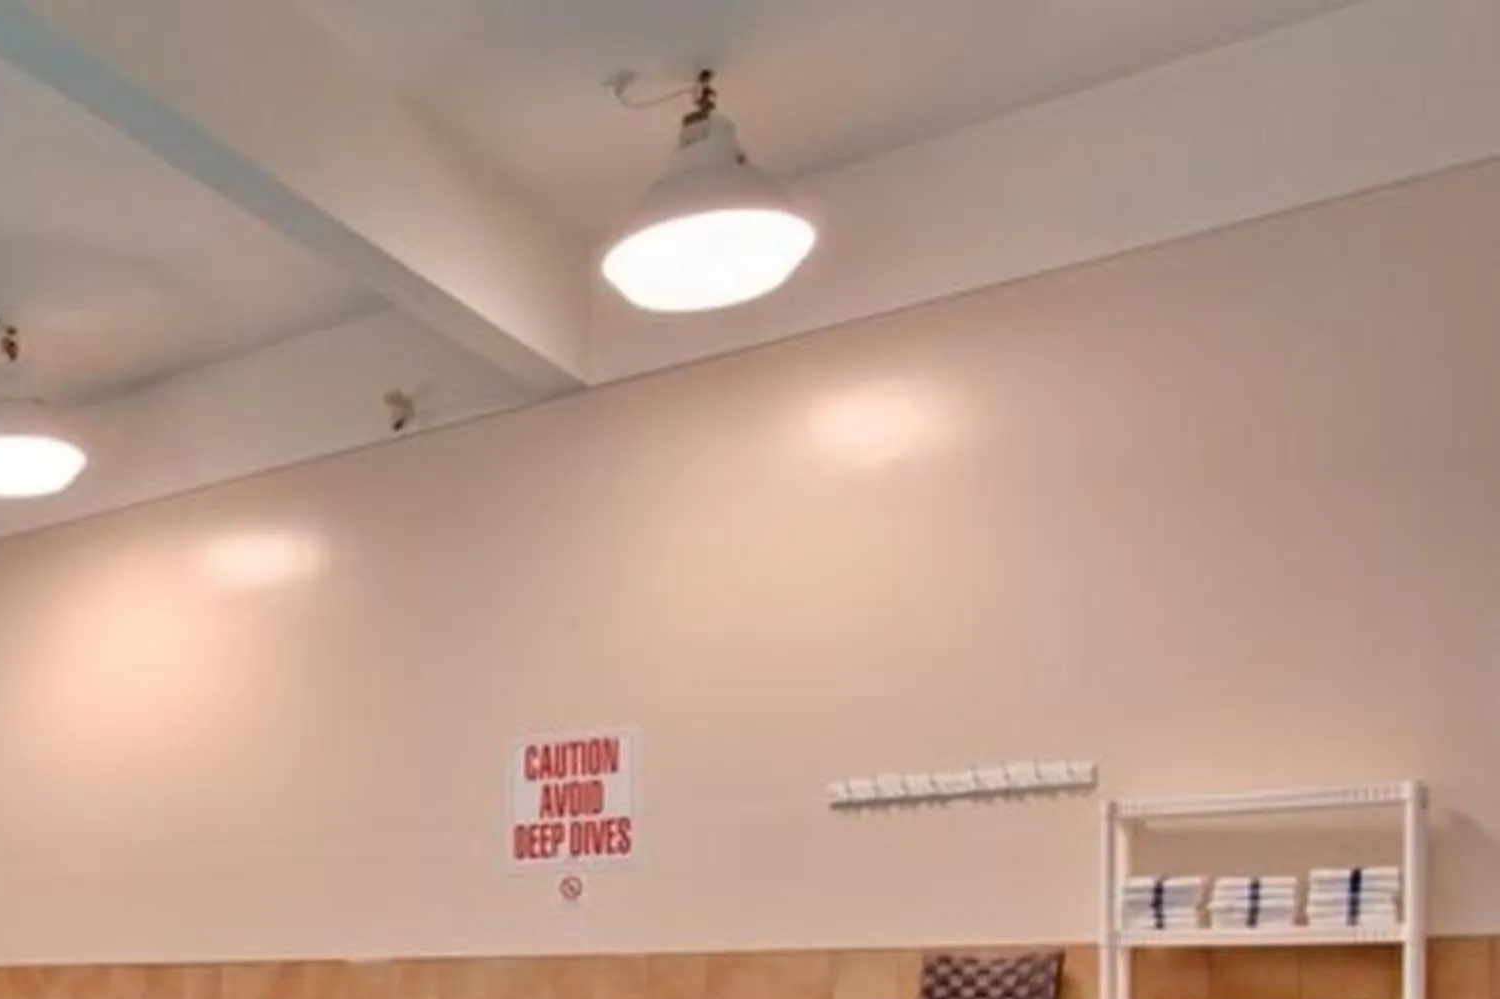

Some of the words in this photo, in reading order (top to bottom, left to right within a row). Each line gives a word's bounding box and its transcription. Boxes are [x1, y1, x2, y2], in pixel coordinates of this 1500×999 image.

[524, 738, 619, 780] CAUTION
[539, 780, 604, 818] AVOID
[513, 823, 564, 859] DEEP
[569, 817, 631, 856] DIVES
